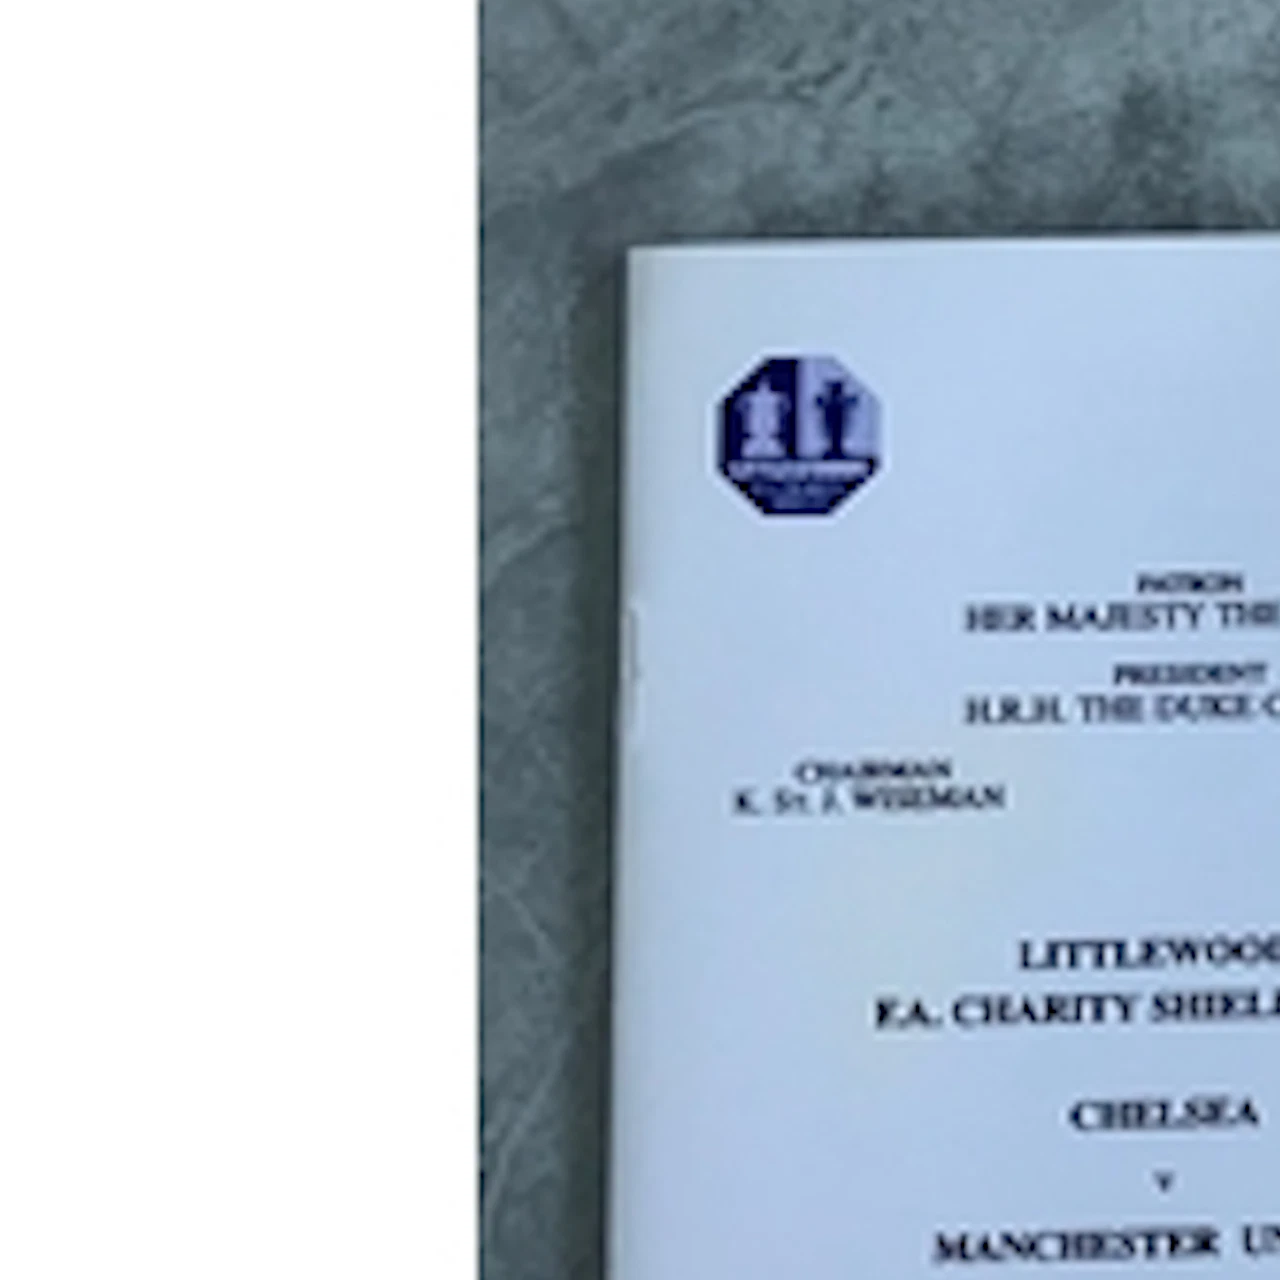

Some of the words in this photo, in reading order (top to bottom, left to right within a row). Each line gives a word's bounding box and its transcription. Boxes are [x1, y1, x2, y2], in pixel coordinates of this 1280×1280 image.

[1136, 572, 1244, 594] PATRON
[965, 604, 1036, 633] HER
[1046, 601, 1205, 632] MAJESTY
[1113, 662, 1268, 686] PRESIDENT
[1077, 693, 1144, 724] THE
[1154, 693, 1251, 722] DUKE
[952, 993, 1135, 1026] CHARITY
[1068, 1096, 1260, 1131] CHELSEA
[936, 1227, 1220, 1263] MANCHESTER
